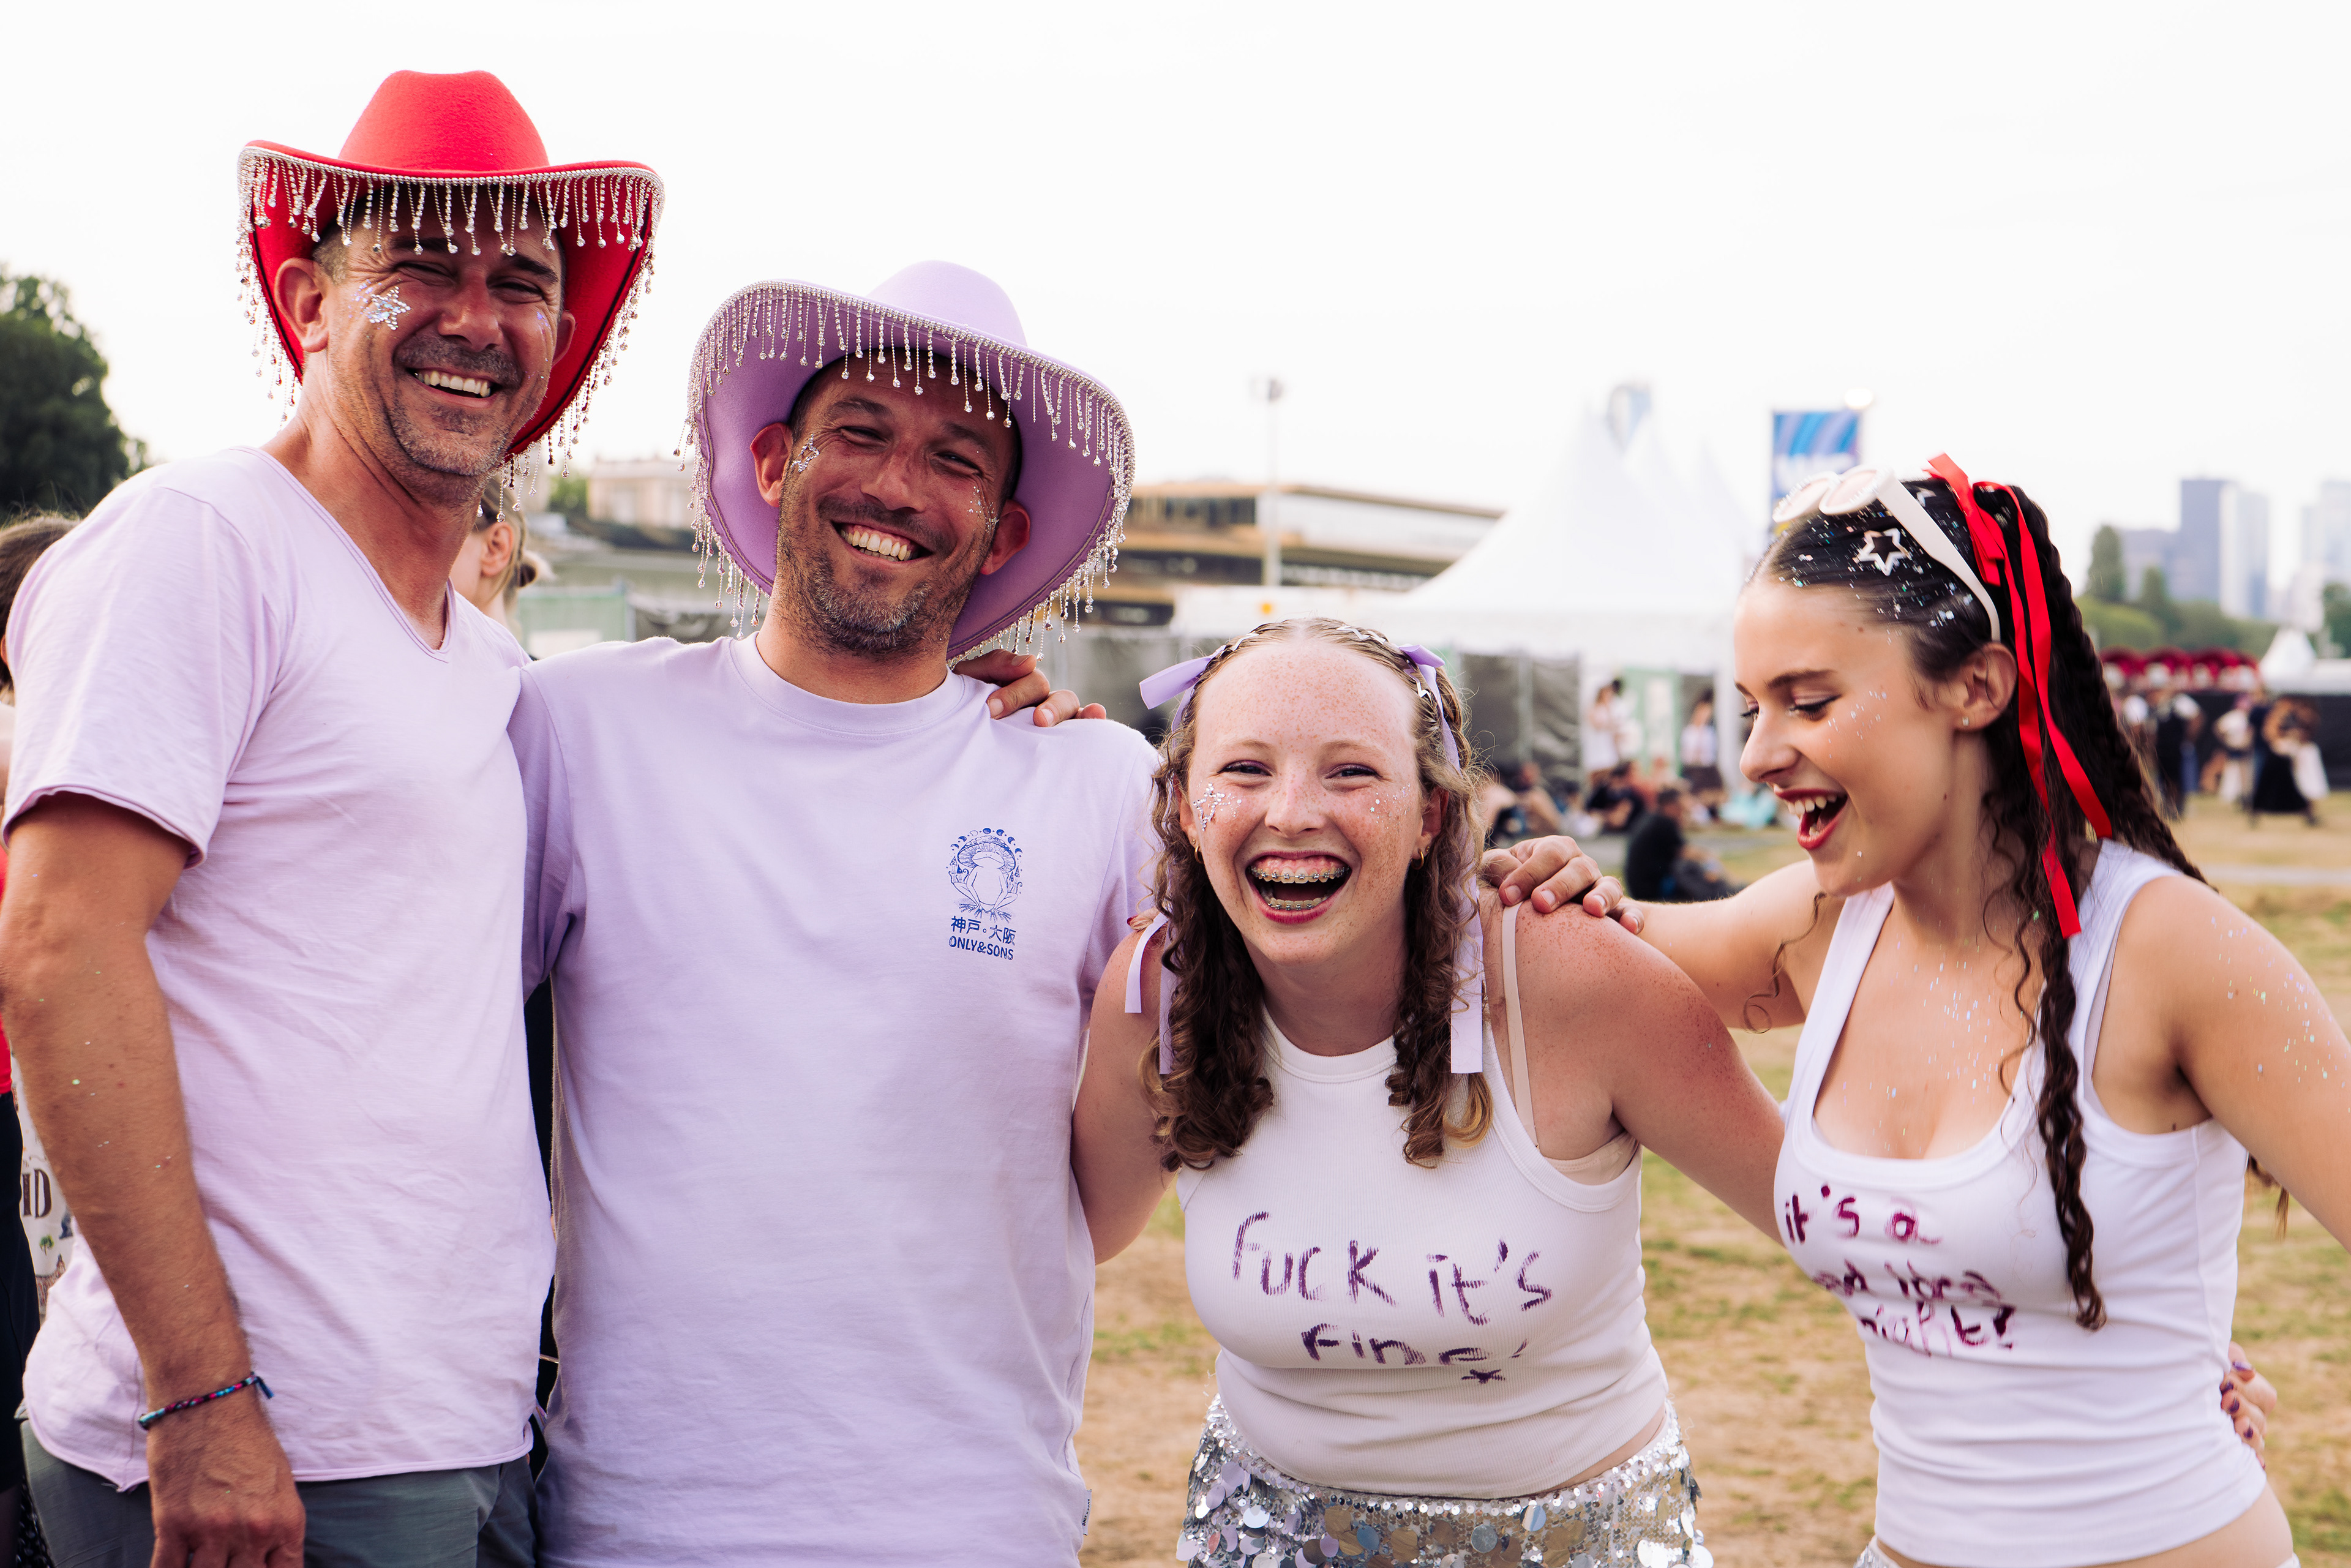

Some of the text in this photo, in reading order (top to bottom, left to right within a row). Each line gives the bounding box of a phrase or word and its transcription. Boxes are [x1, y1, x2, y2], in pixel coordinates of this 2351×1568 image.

[949, 936, 1014, 960] ONLY&SONS
[1884, 1207, 1942, 1245] a
[1427, 1238, 1553, 1326] it's
